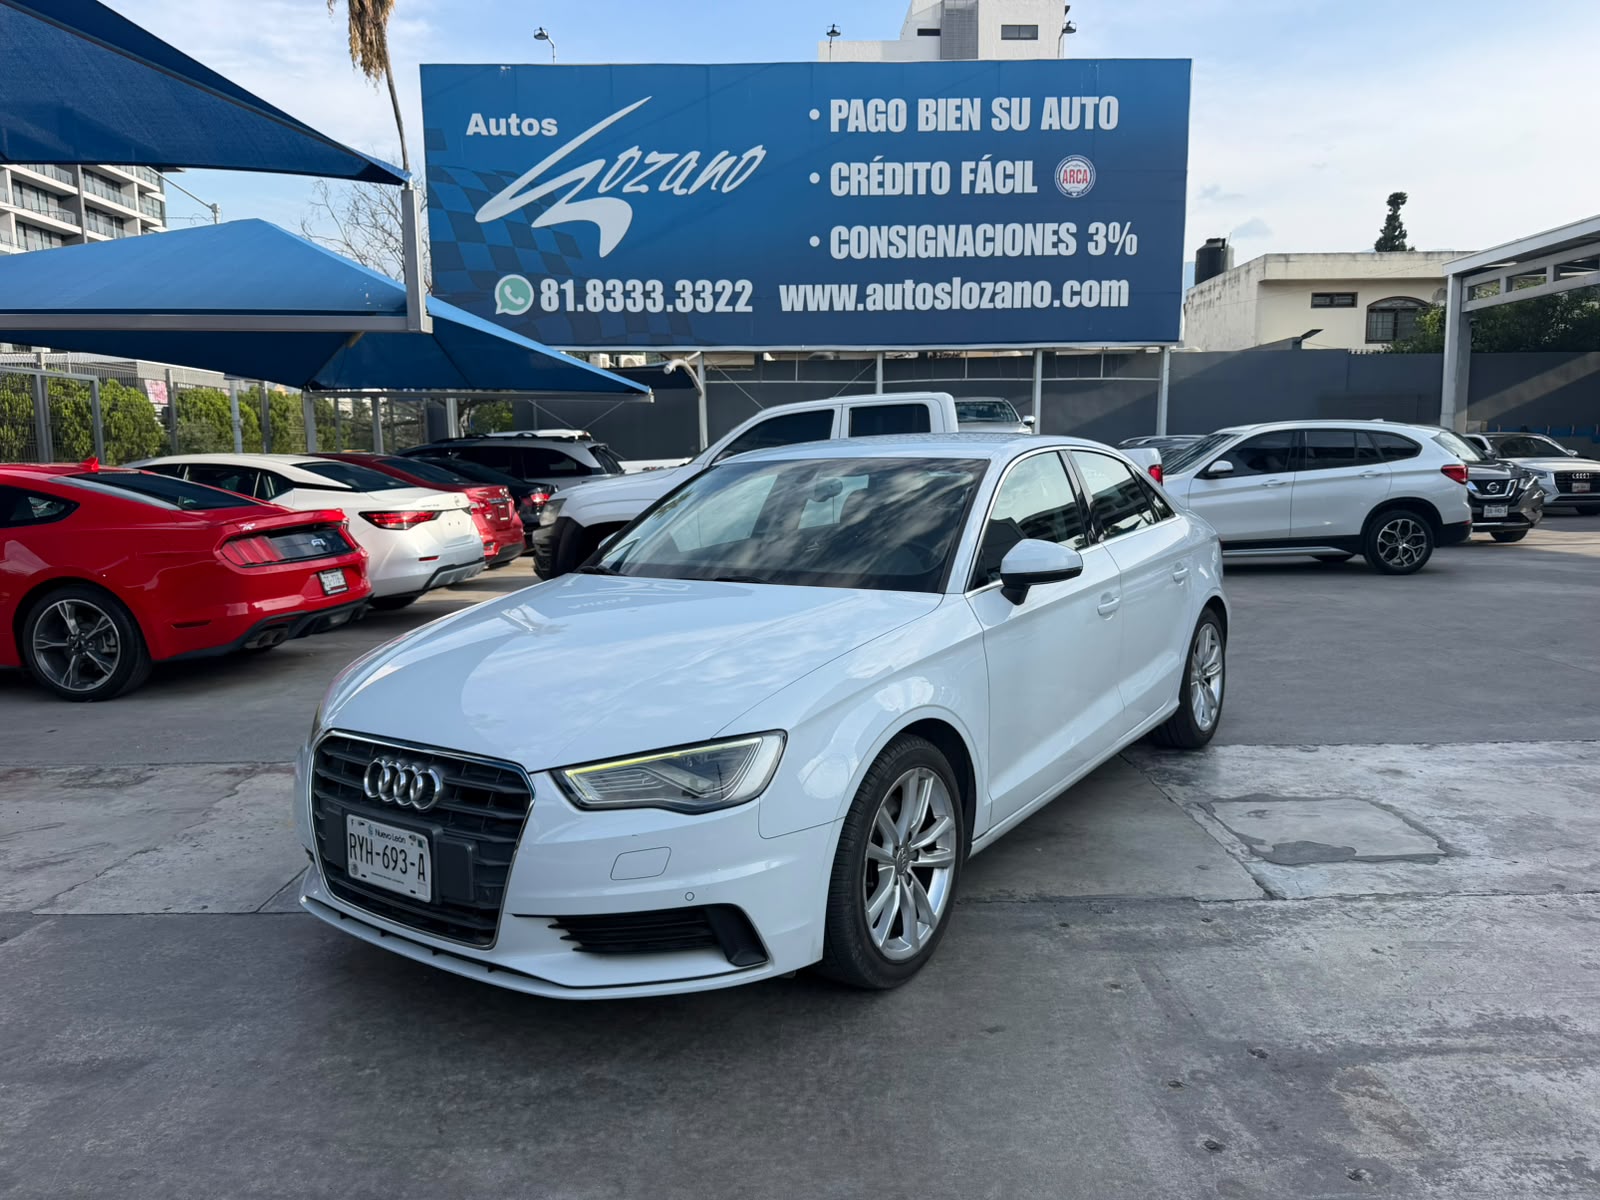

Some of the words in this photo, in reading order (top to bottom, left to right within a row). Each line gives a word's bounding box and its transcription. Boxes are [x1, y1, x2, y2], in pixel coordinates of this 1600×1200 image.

[466, 113, 558, 136] Autos
[830, 97, 907, 133] PAGO
[917, 97, 981, 132] BIEN
[991, 96, 1031, 132] SU
[1040, 95, 1119, 131] AUTO
[475, 96, 767, 258] Lozano
[830, 155, 951, 197] CRÉDITO
[961, 154, 1038, 195] FÁCIL
[1062, 169, 1088, 184] ARCA
[830, 222, 1077, 260] CONSIGNACIONES
[1087, 221, 1138, 256] 3%
[540, 279, 753, 313] 81.8333.3322
[779, 277, 1129, 312] www.autoslozano.com
[349, 833, 426, 882] RYH-693-A
